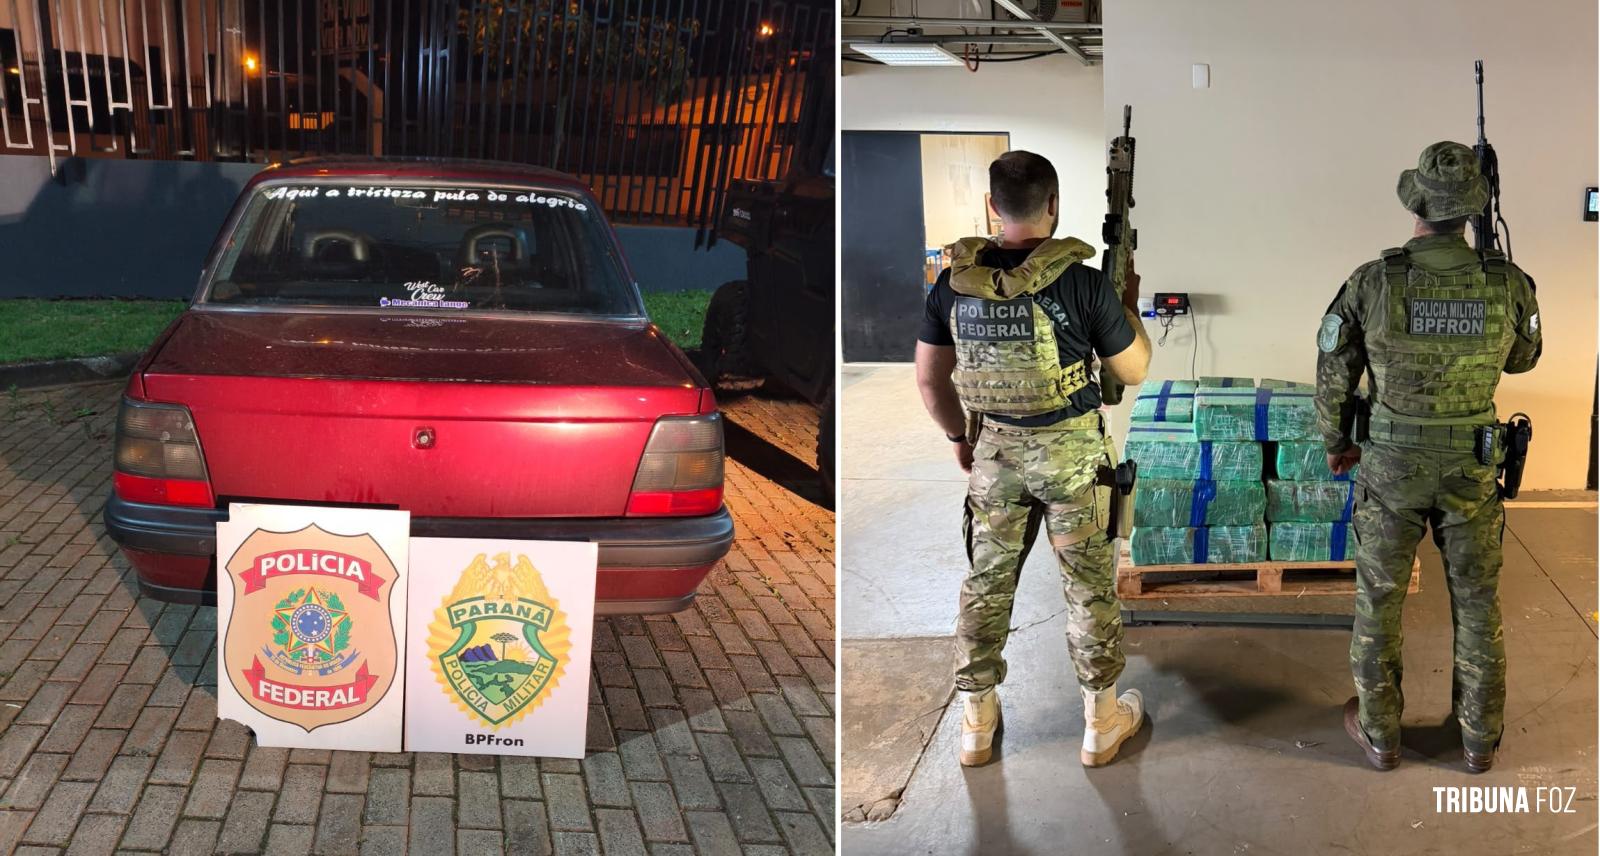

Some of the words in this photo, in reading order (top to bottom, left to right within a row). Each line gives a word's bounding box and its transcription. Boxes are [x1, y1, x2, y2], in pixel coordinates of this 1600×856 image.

[266, 187, 319, 200] Aqui
[325, 189, 340, 197] a
[347, 187, 427, 199] tristeza
[433, 190, 480, 202] pula
[487, 190, 507, 201] de
[515, 192, 588, 212] alegria
[411, 288, 446, 301] Crew
[959, 303, 1030, 319] POLÍCIA
[1449, 302, 1484, 318] MILITAR
[959, 322, 1031, 337] FEDERAL
[1412, 318, 1484, 334] BPFRON
[260, 553, 365, 581] POLÍCIA
[453, 602, 546, 624] PARANÁ
[259, 680, 360, 707] FEDERAL
[502, 661, 550, 713] MILITAR
[465, 733, 524, 747] BPFron
